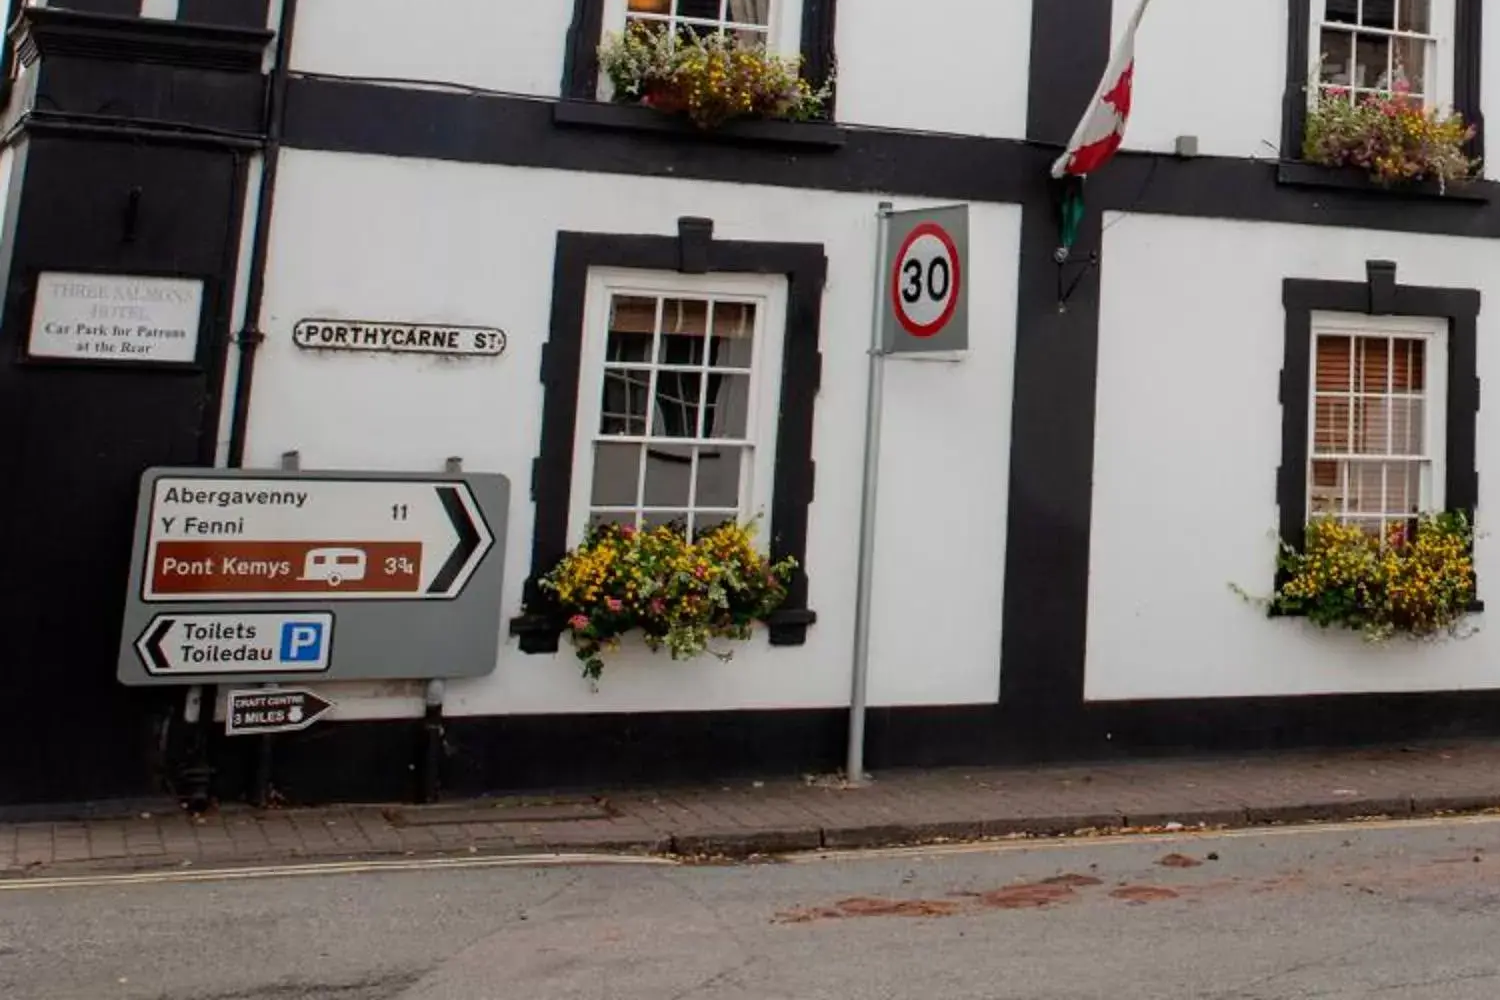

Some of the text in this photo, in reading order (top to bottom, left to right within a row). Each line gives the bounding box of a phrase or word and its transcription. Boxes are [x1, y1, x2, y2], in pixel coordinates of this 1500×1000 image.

[902, 256, 949, 303] 30
[45, 323, 70, 335] Car
[76, 323, 107, 336] Park
[112, 325, 132, 337] for
[305, 325, 459, 348] PORTHYCARNE
[76, 342, 89, 352] at
[95, 341, 115, 353] the
[164, 487, 308, 507] Abergavenny
[391, 504, 408, 520] 11
[161, 517, 244, 534] Y Fenni
[162, 557, 213, 575] Pont
[223, 557, 291, 580] Kemys
[184, 623, 256, 639] Toilets
[181, 645, 273, 662] Toiledau
[245, 710, 285, 724] MILES
